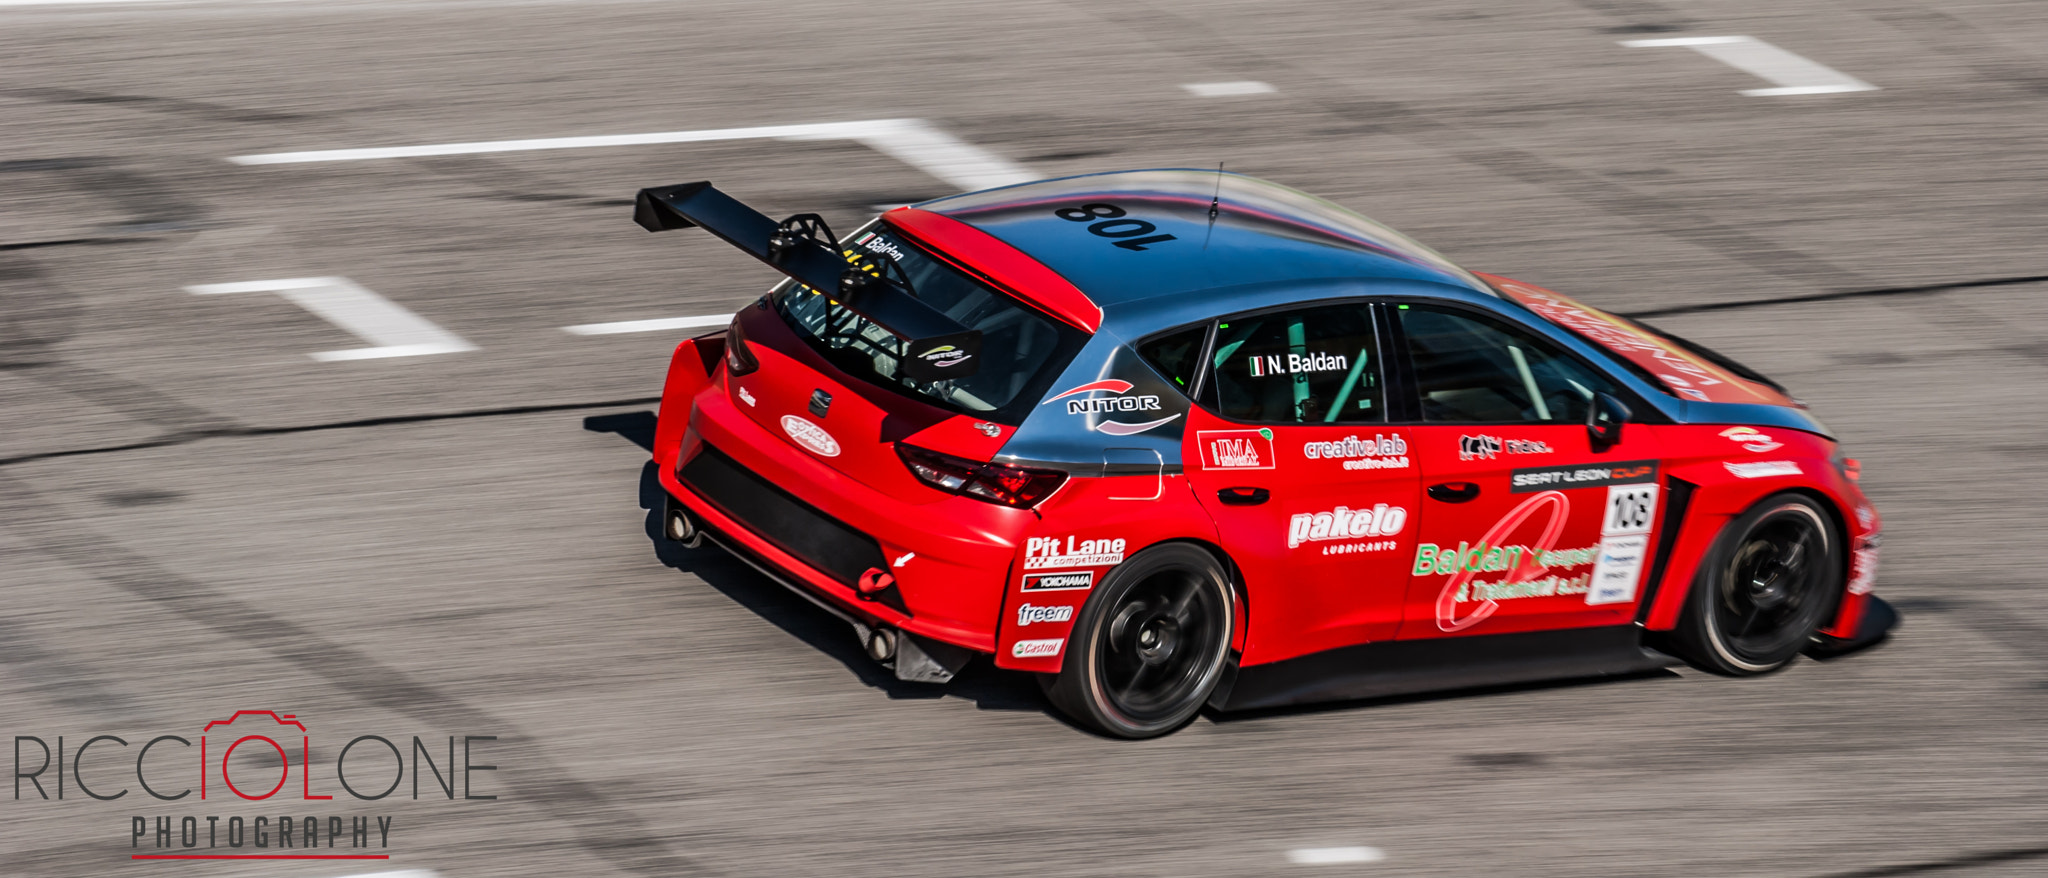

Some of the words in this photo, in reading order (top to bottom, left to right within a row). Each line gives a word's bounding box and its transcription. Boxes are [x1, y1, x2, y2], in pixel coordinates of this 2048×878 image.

[1055, 203, 1178, 251] 108
[865, 236, 904, 262] Baldan
[1267, 355, 1286, 374] N.
[1287, 351, 1348, 373] Baldan
[1067, 395, 1162, 415] NITOR
[1513, 471, 1563, 486] SEAT
[1563, 468, 1611, 482] LEON
[1611, 466, 1652, 479] CUP
[1288, 504, 1407, 548] pakelo
[1026, 537, 1061, 558] Pit
[1066, 535, 1126, 557] Lane
[1322, 541, 1397, 555] LUBRICANTS
[1053, 554, 1121, 566] competizioni
[1412, 541, 1524, 576] Baldan
[1040, 575, 1090, 588] YOKOHAMA
[1018, 603, 1073, 626] freem
[1025, 643, 1058, 654] Castrol
